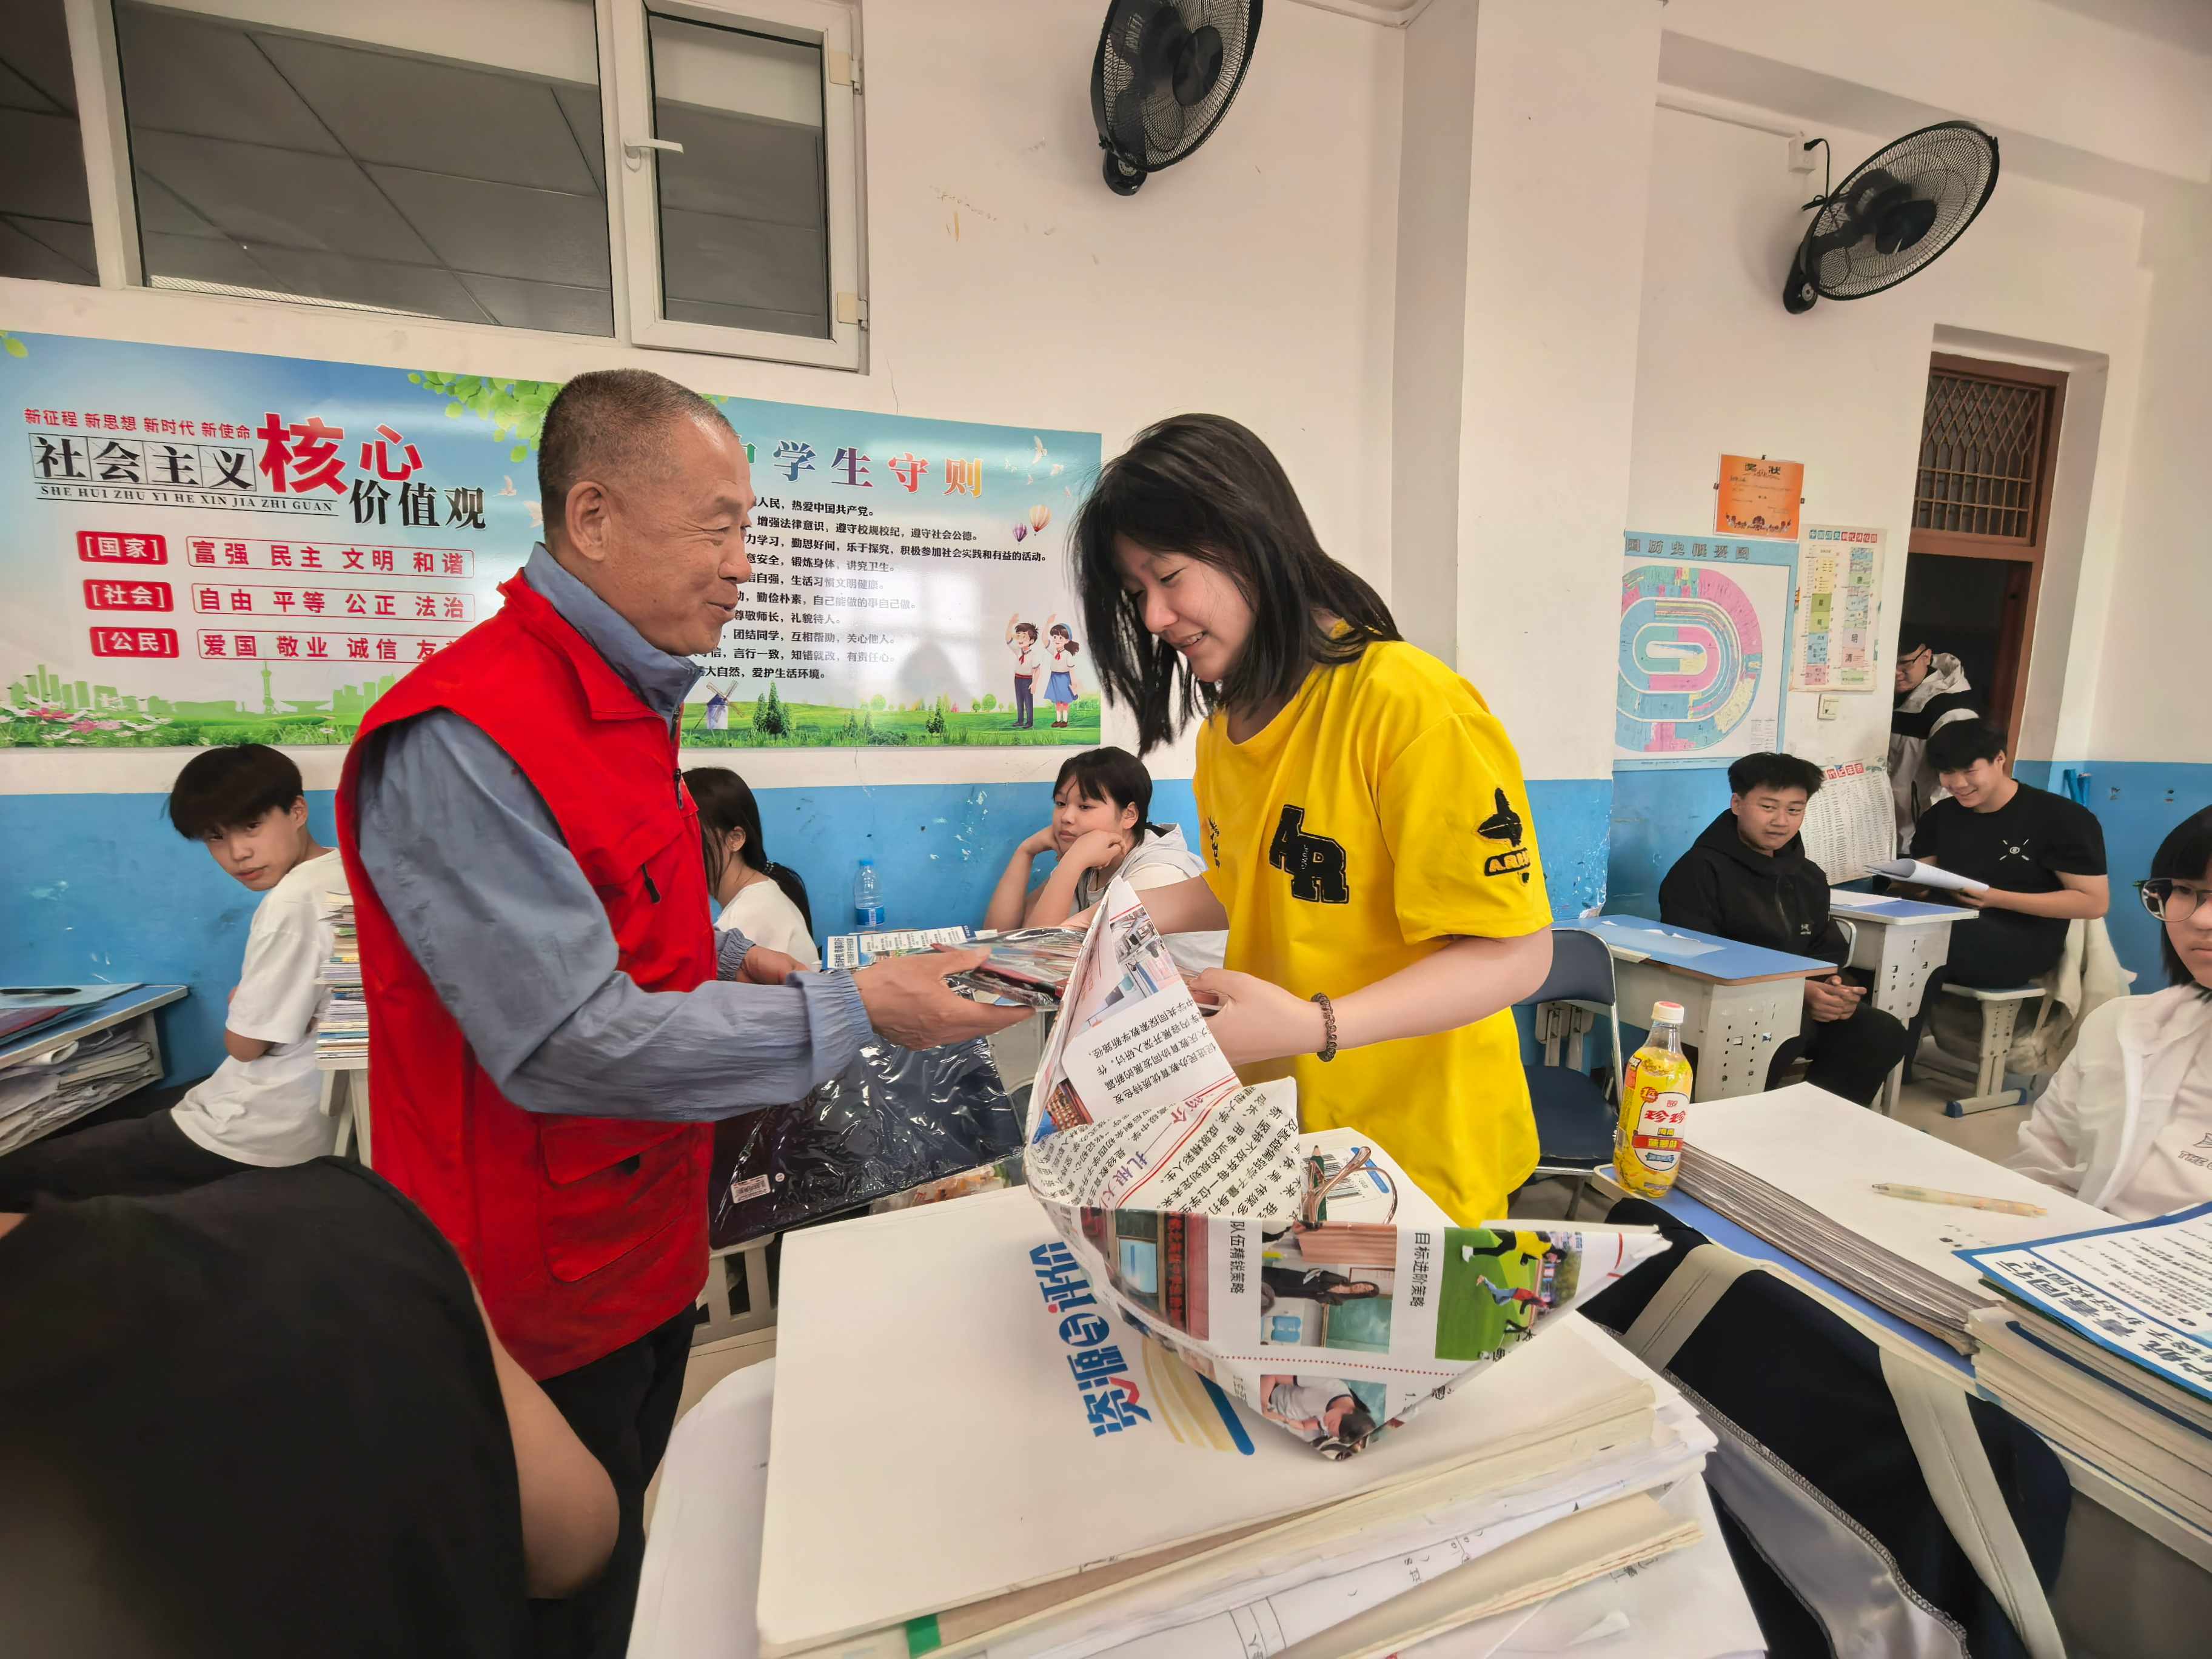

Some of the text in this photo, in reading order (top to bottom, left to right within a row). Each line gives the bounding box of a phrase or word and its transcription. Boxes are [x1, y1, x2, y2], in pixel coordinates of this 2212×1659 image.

[24, 408, 250, 440] 新征程 新思想 新时代 新使命
[36, 436, 253, 490] 社会主义
[256, 412, 424, 495] 核心
[41, 486, 332, 511] SHE HUI ZHU YI HE XIN JIA ZHI GUAN
[349, 479, 486, 529] 价值观
[754, 497, 873, 517] 人民，热爱中国共产党。
[193, 541, 463, 575] 富强 民主 文明 和谐
[200, 588, 464, 618] 自由 平等 公正 法治
[203, 634, 257, 657] 爱国
[276, 635, 329, 657] 敬业
[346, 637, 397, 661] 诚信
[700, 666, 825, 680] 大自然，爱护生活环境。
[1229, 1220, 1245, 1295] 队伍精锐策略
[1410, 1232, 1430, 1308] 目标进阶策略
